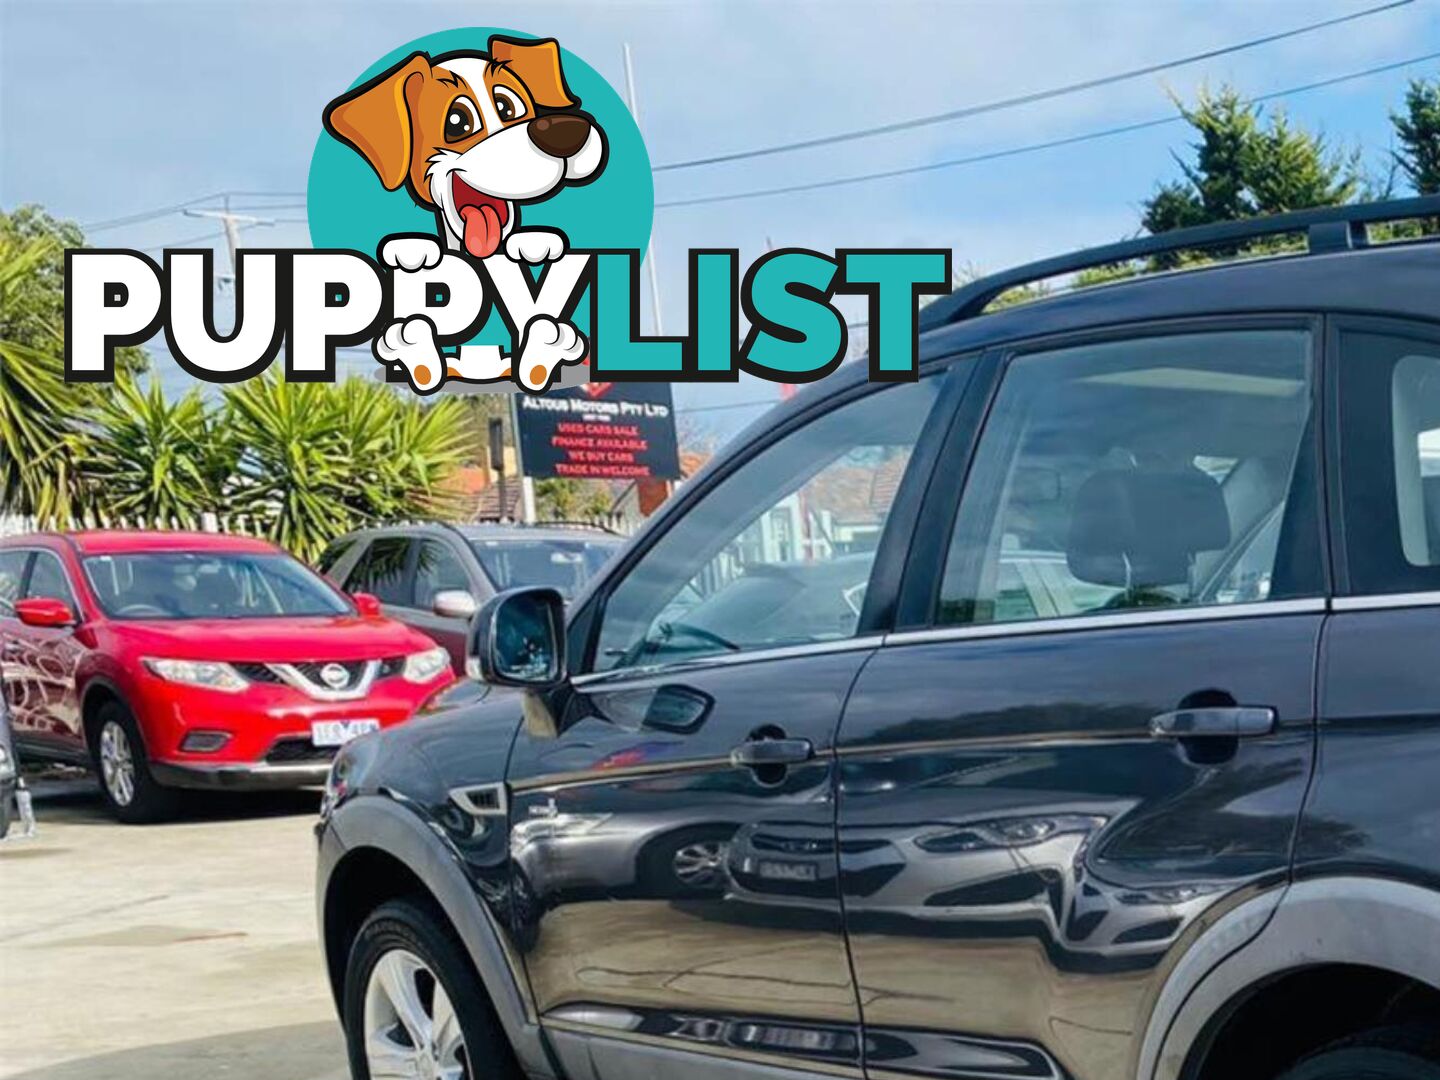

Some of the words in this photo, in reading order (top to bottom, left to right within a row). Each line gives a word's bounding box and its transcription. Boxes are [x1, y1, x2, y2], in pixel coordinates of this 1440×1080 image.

[558, 423, 584, 433] USED
[585, 424, 612, 434] CARS
[613, 425, 639, 436] SALE
[552, 436, 594, 447] FINANCE
[596, 438, 647, 450] AVAILABLE
[568, 451, 585, 461] WE
[586, 451, 605, 462] BUY
[606, 452, 634, 462] CARS
[555, 463, 588, 474] TRADE
[601, 465, 650, 476] WELCOME
